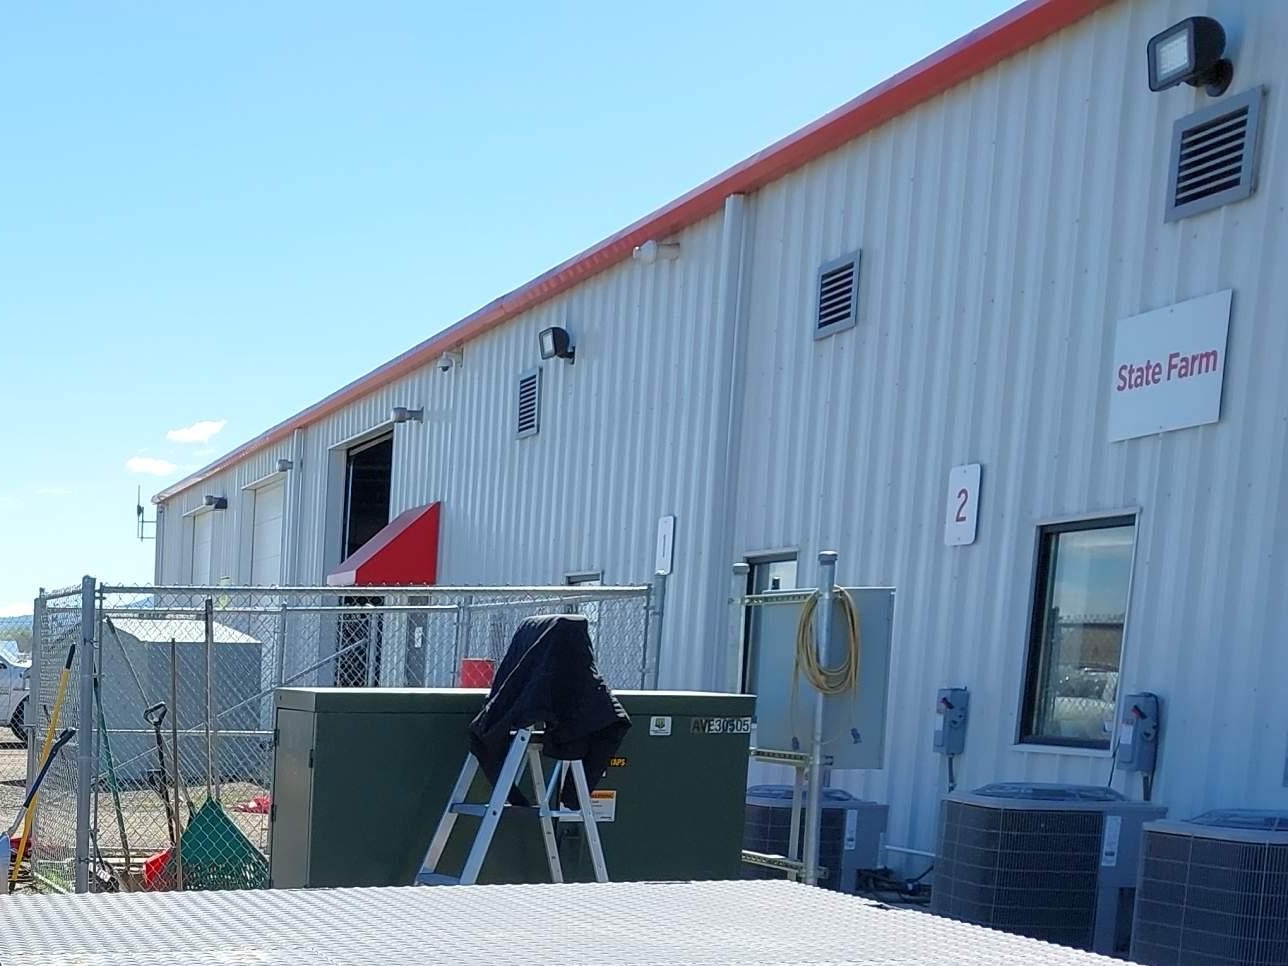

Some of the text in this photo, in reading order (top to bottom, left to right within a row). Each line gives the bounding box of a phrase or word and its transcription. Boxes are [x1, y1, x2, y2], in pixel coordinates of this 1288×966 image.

[1116, 350, 1218, 392] State Farm
[955, 488, 968, 522] 2
